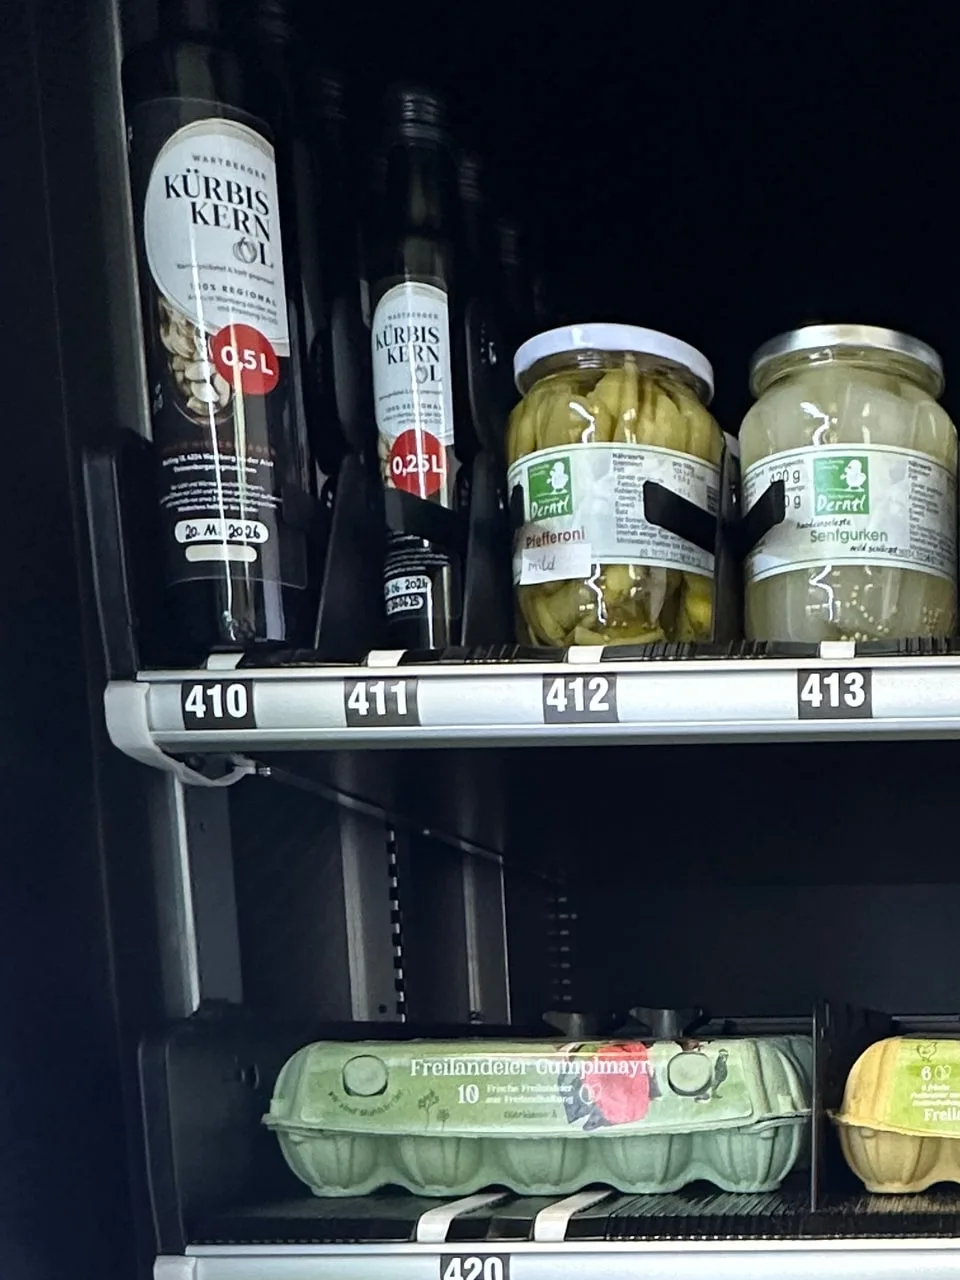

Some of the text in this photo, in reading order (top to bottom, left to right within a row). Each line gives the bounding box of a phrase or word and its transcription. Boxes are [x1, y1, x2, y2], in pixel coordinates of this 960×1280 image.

[164, 168, 269, 215] KÜRBIS
[191, 202, 270, 242] KERN
[376, 324, 440, 351] KÜRBIS
[387, 345, 439, 365] KERN
[817, 494, 865, 512] Derntl
[526, 527, 585, 549] Pfefferoni
[810, 529, 888, 544] Senfgurken
[528, 557, 555, 572] mild
[348, 681, 407, 715] 411
[546, 677, 609, 712] 412
[801, 672, 865, 707] 413
[185, 684, 247, 718] 410
[410, 1057, 653, 1079] Freilandeier Gumplmayr
[921, 1066, 932, 1081] 6
[457, 1084, 479, 1104] 10
